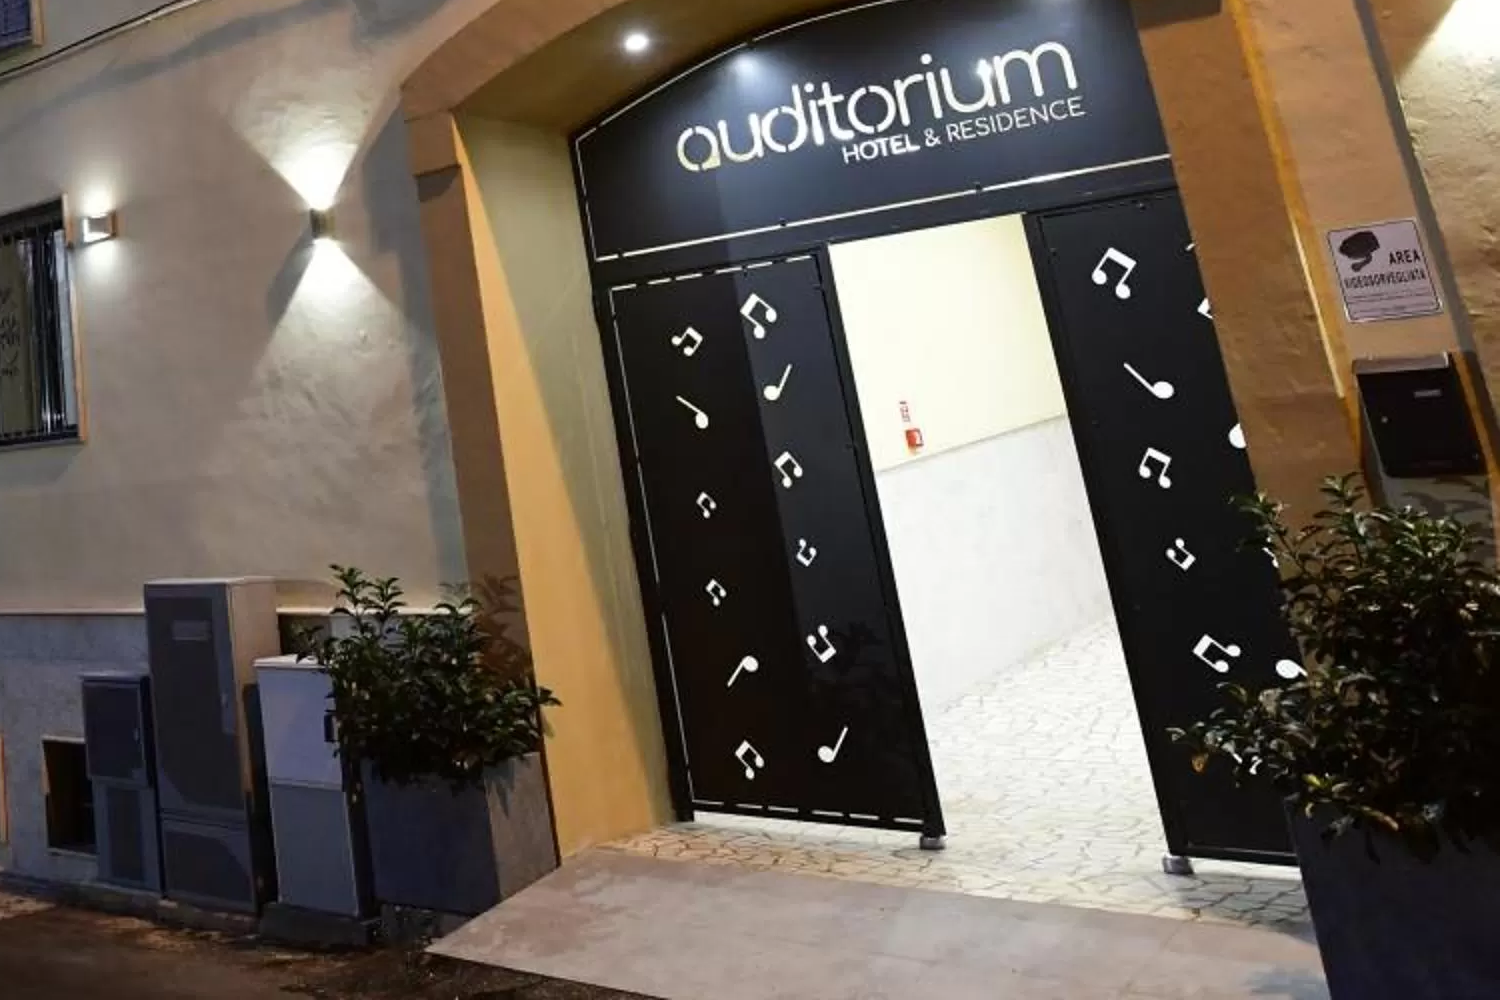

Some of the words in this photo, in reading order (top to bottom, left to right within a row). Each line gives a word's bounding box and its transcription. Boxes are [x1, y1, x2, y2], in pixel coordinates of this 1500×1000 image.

[677, 41, 1079, 172] auditorium
[842, 134, 920, 164] HOTEL
[924, 128, 942, 147] &
[947, 96, 1087, 142] RESIDENCE
[1389, 249, 1421, 265] AREA
